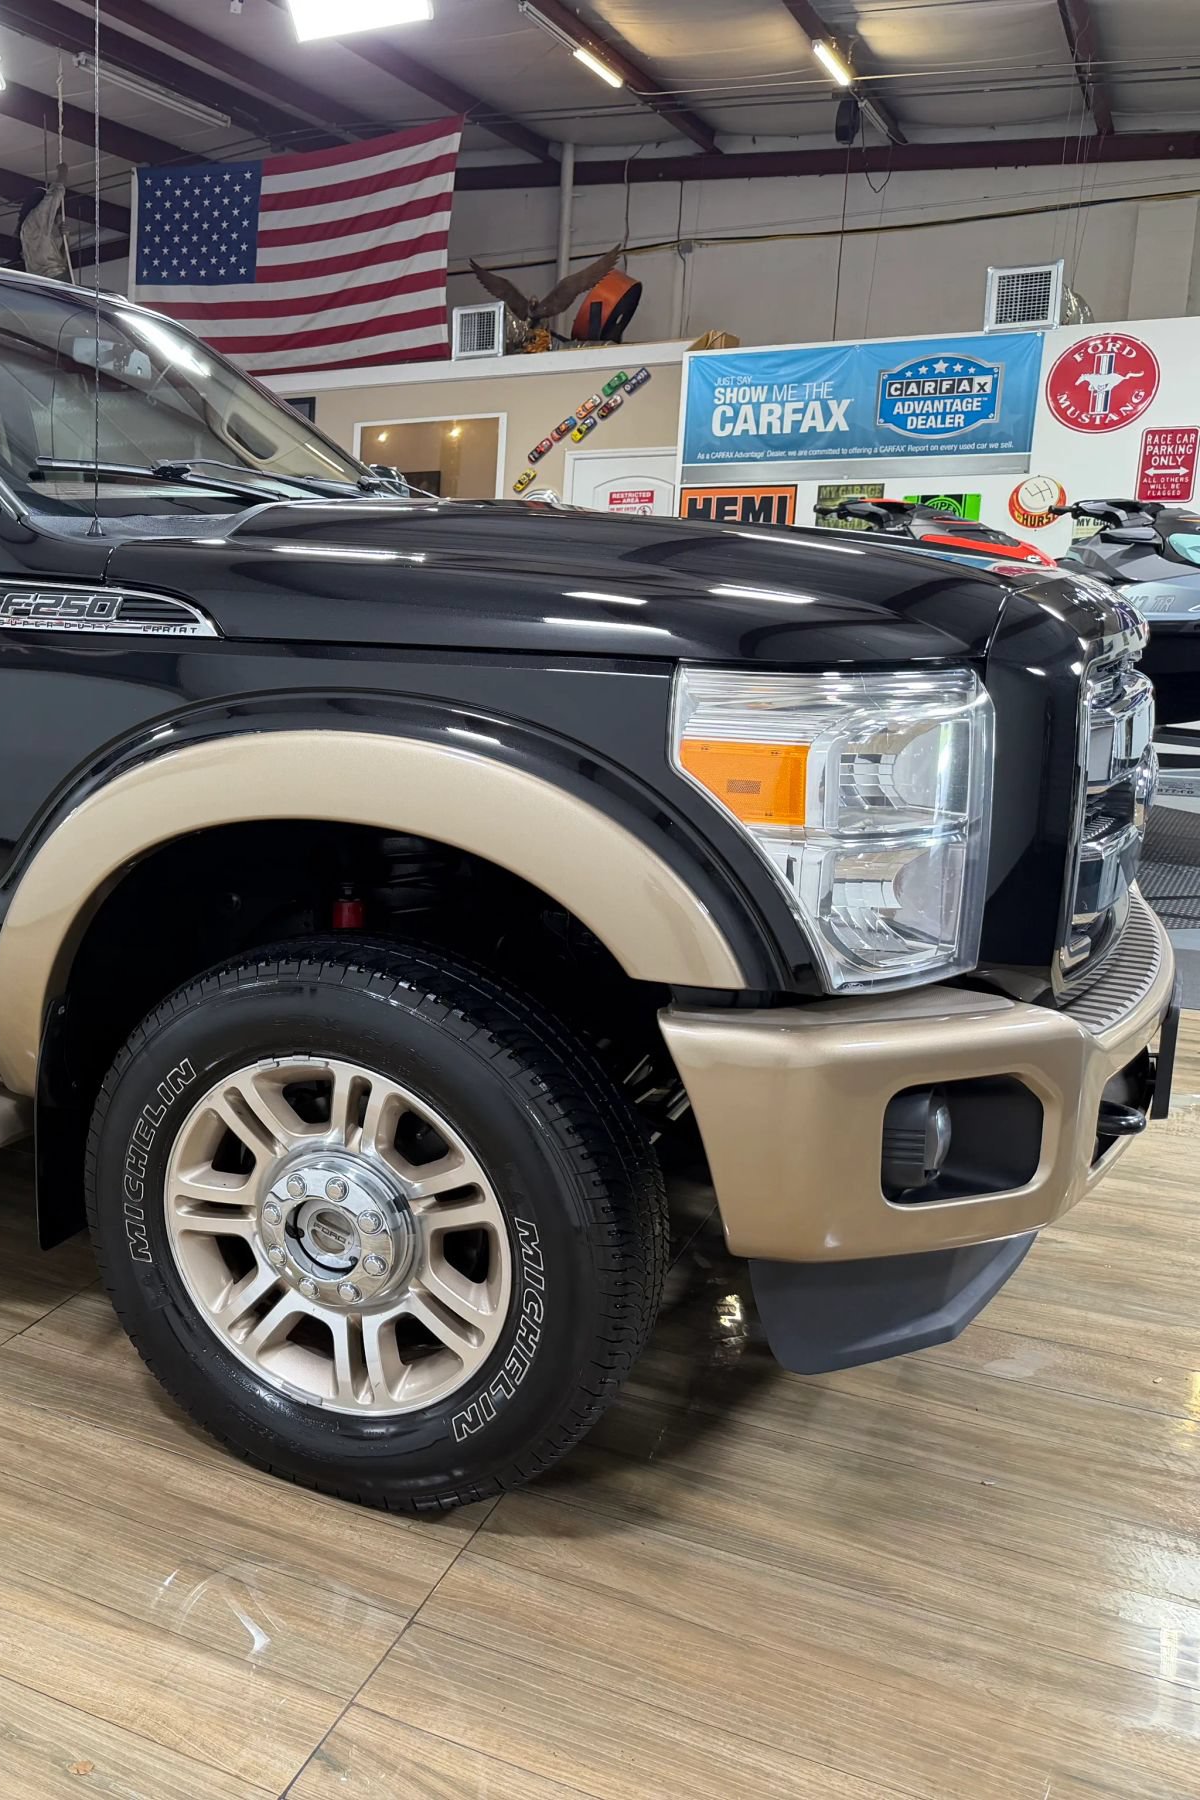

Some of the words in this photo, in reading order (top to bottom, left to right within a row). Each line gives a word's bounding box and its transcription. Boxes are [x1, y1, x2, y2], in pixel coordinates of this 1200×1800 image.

[1073, 341, 1137, 363] FORD
[715, 377, 735, 386] JUST
[736, 376, 752, 385] SAY
[714, 386, 768, 405] SHOW
[772, 384, 798, 402] ME
[802, 381, 834, 400] THE
[887, 376, 993, 401] CARFAX
[1057, 389, 1146, 424] MUSTANG
[907, 414, 965, 430] DEALER
[1146, 433, 1172, 444] RACE
[1177, 433, 1196, 444] CAR
[907, 445, 929, 453] Report
[940, 444, 958, 452] every
[1146, 444, 1193, 456] PARKING
[1151, 456, 1184, 466] ONLY
[820, 486, 837, 499] MY
[686, 494, 793, 525] HEMI
[1076, 518, 1090, 527] MY
[64, 621, 109, 630] DUTY
[143, 625, 197, 634] LARIAT
[121, 1057, 197, 1263] MICHELIN
[451, 1215, 546, 1442] MICHELIN
